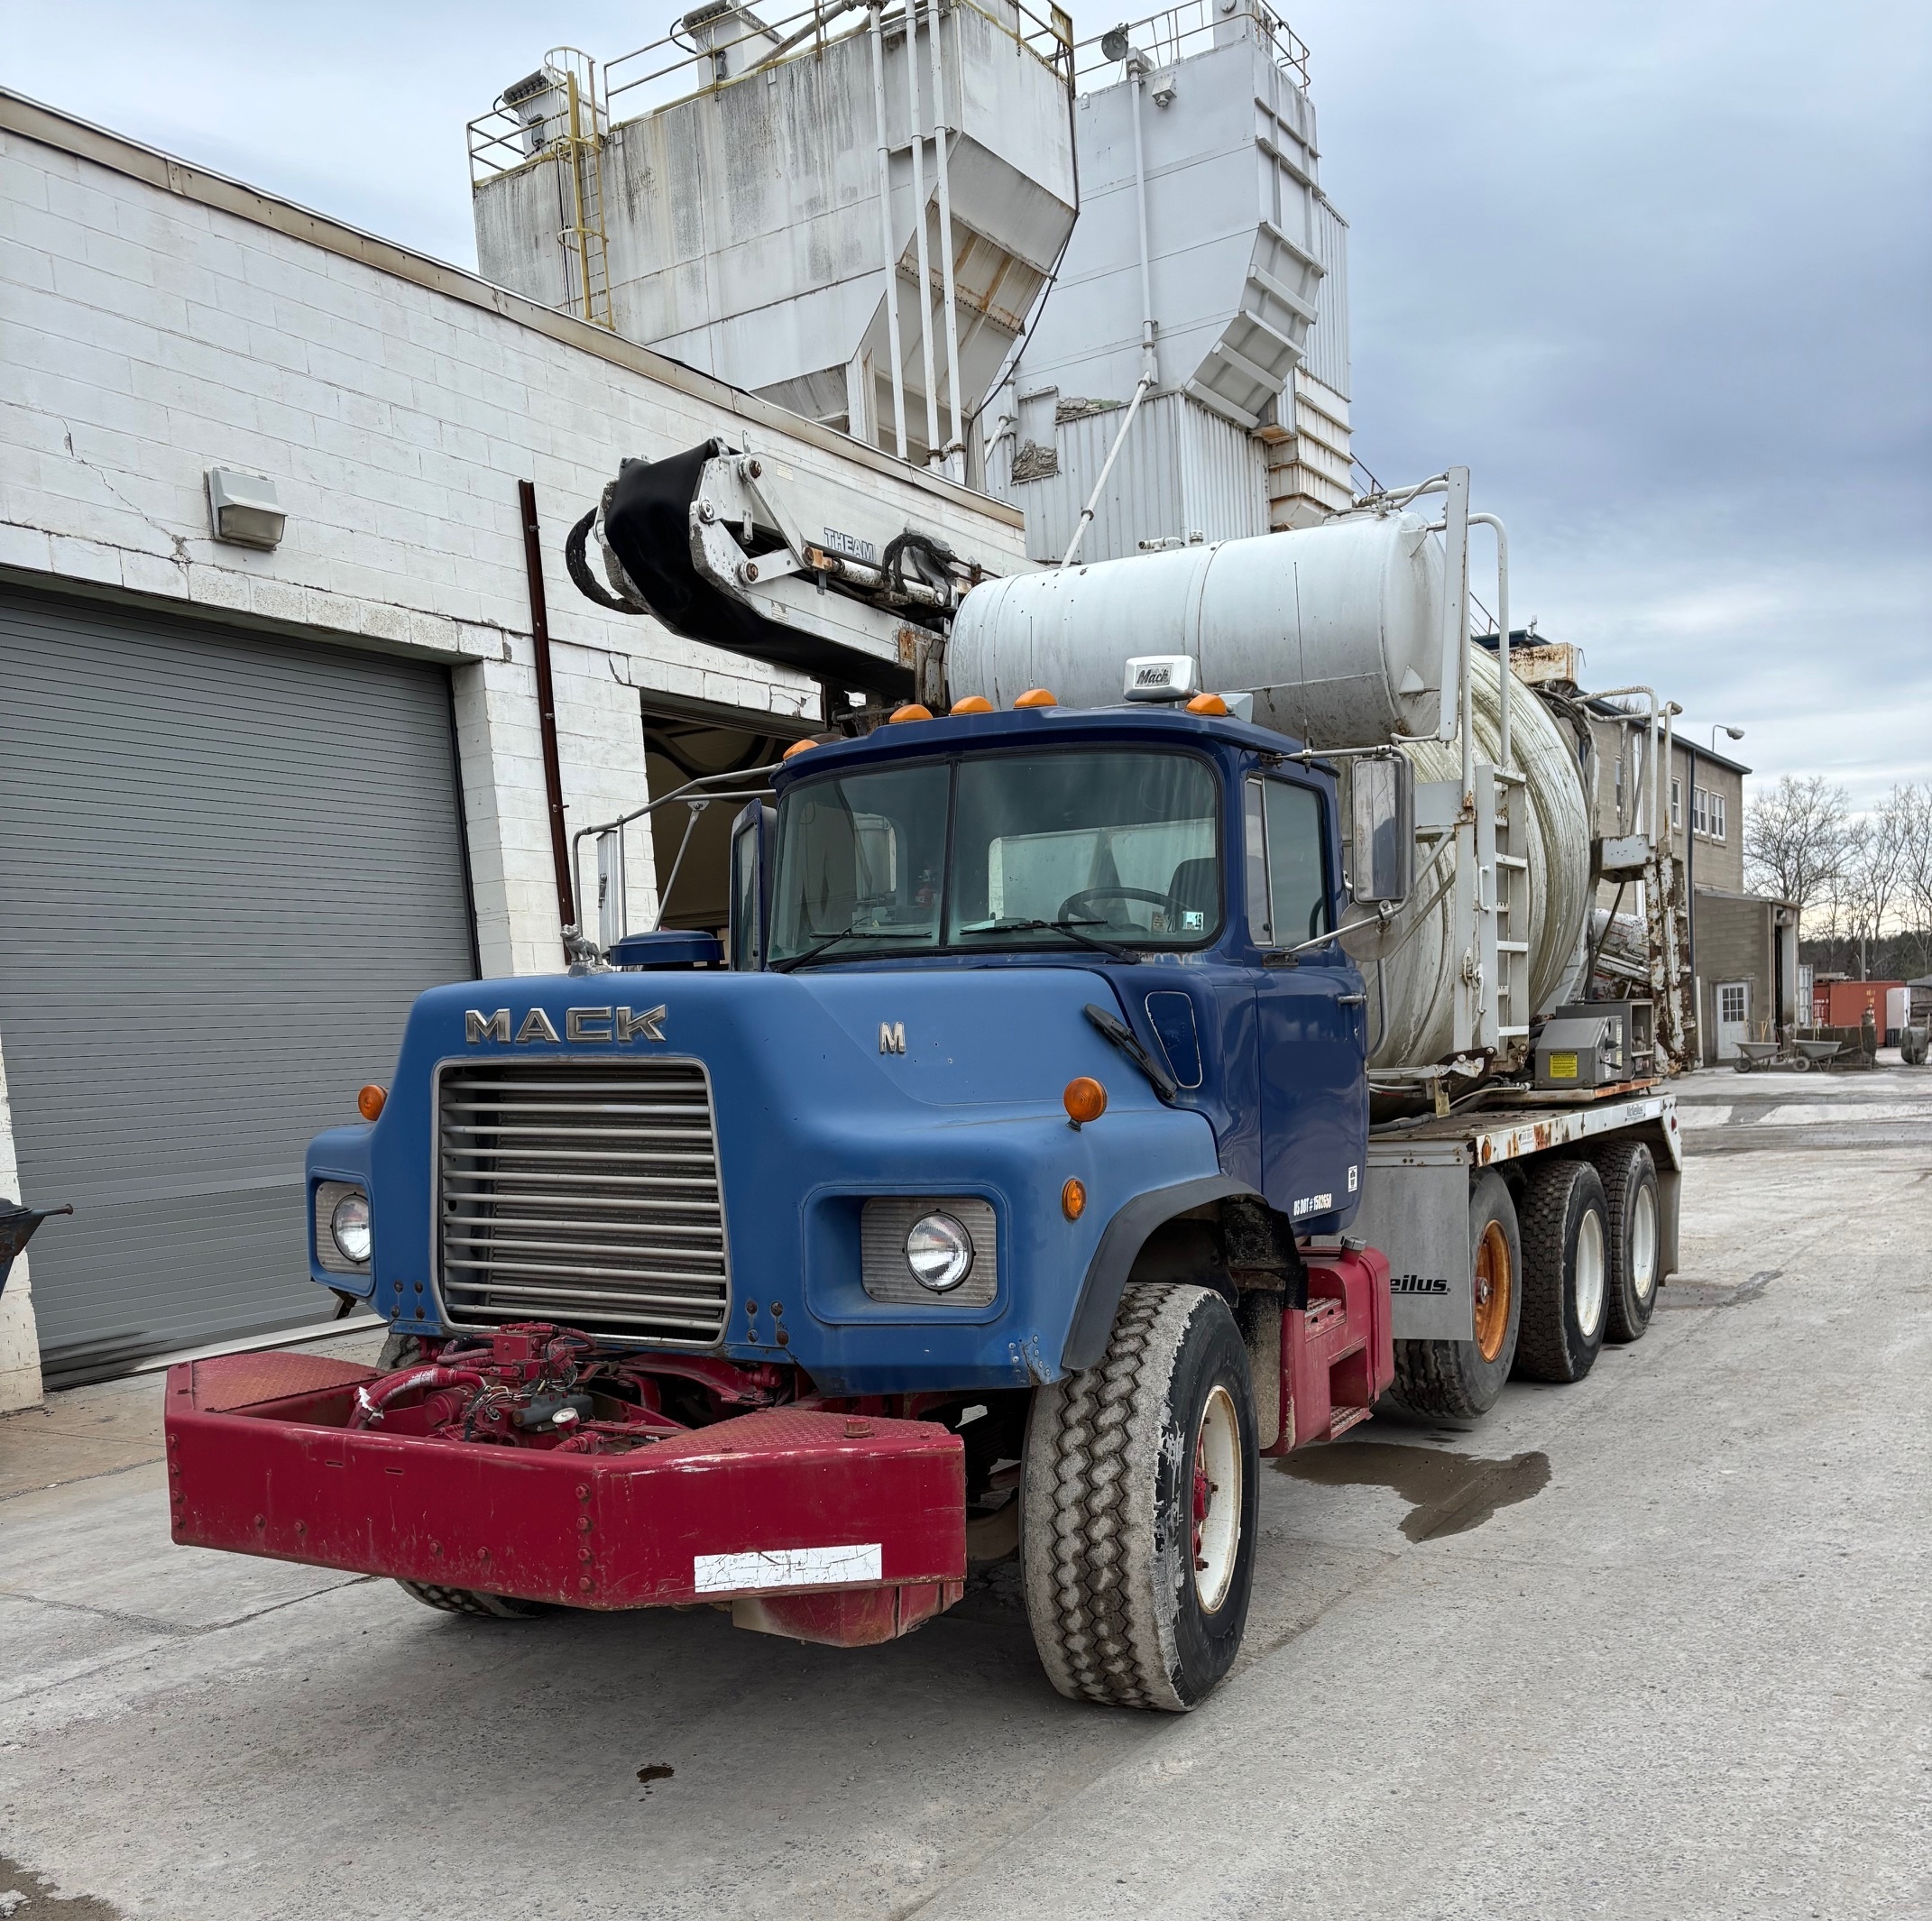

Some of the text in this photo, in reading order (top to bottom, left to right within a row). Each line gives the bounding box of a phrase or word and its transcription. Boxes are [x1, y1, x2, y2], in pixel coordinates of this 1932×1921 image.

[824, 528, 874, 562] THEAM
[1136, 668, 1169, 685] Mack
[465, 1004, 667, 1043] MACK
[879, 1021, 906, 1054] M
[1390, 1274, 1448, 1291] eilus
